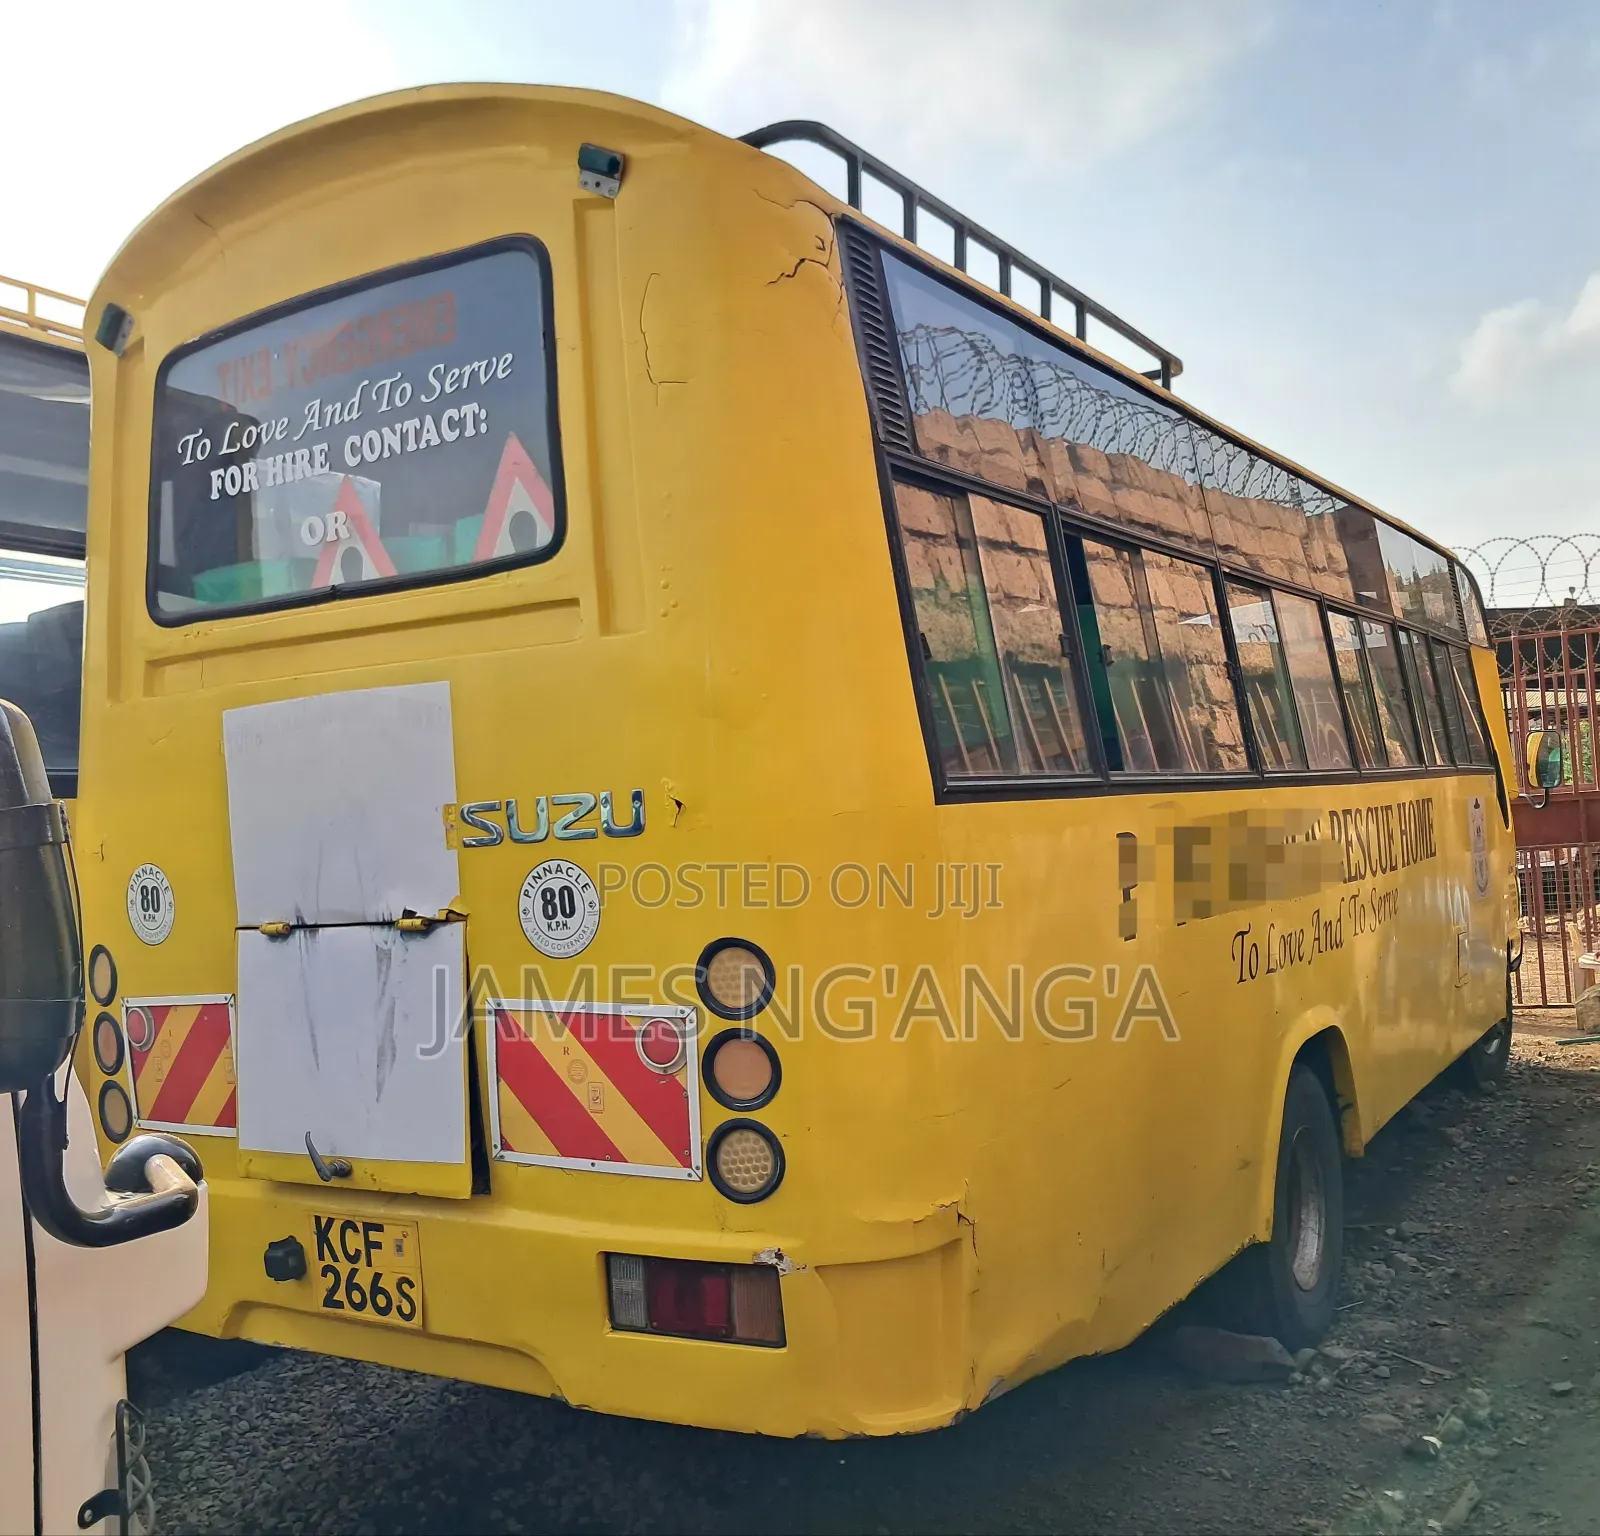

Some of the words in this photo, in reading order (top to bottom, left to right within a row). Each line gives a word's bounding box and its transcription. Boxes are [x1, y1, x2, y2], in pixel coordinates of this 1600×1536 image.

[177, 427, 212, 467] To
[218, 416, 289, 457] Love
[292, 379, 370, 442] And
[371, 371, 412, 415] To
[420, 352, 514, 405] Serve
[209, 459, 260, 501] FOR
[266, 443, 331, 488] HIRE
[343, 402, 490, 468] CONTACT:
[300, 510, 351, 546] OR
[1396, 797, 1437, 869] HOME
[129, 866, 170, 895] PINNACLE
[523, 863, 592, 899] PINNACLE
[140, 885, 161, 913] 80
[540, 885, 576, 920] 80
[531, 928, 550, 947] SPEED
[550, 925, 590, 951] GOVERNORS
[546, 920, 571, 932] K.P.H.
[1231, 922, 1259, 985] To
[1265, 922, 1305, 975] Love
[1307, 896, 1345, 966] And
[1348, 888, 1366, 938] To
[1368, 887, 1399, 933] Serve
[563, 1046, 570, 1056] R
[314, 1214, 385, 1268] KCF
[320, 1263, 417, 1322] 266S
